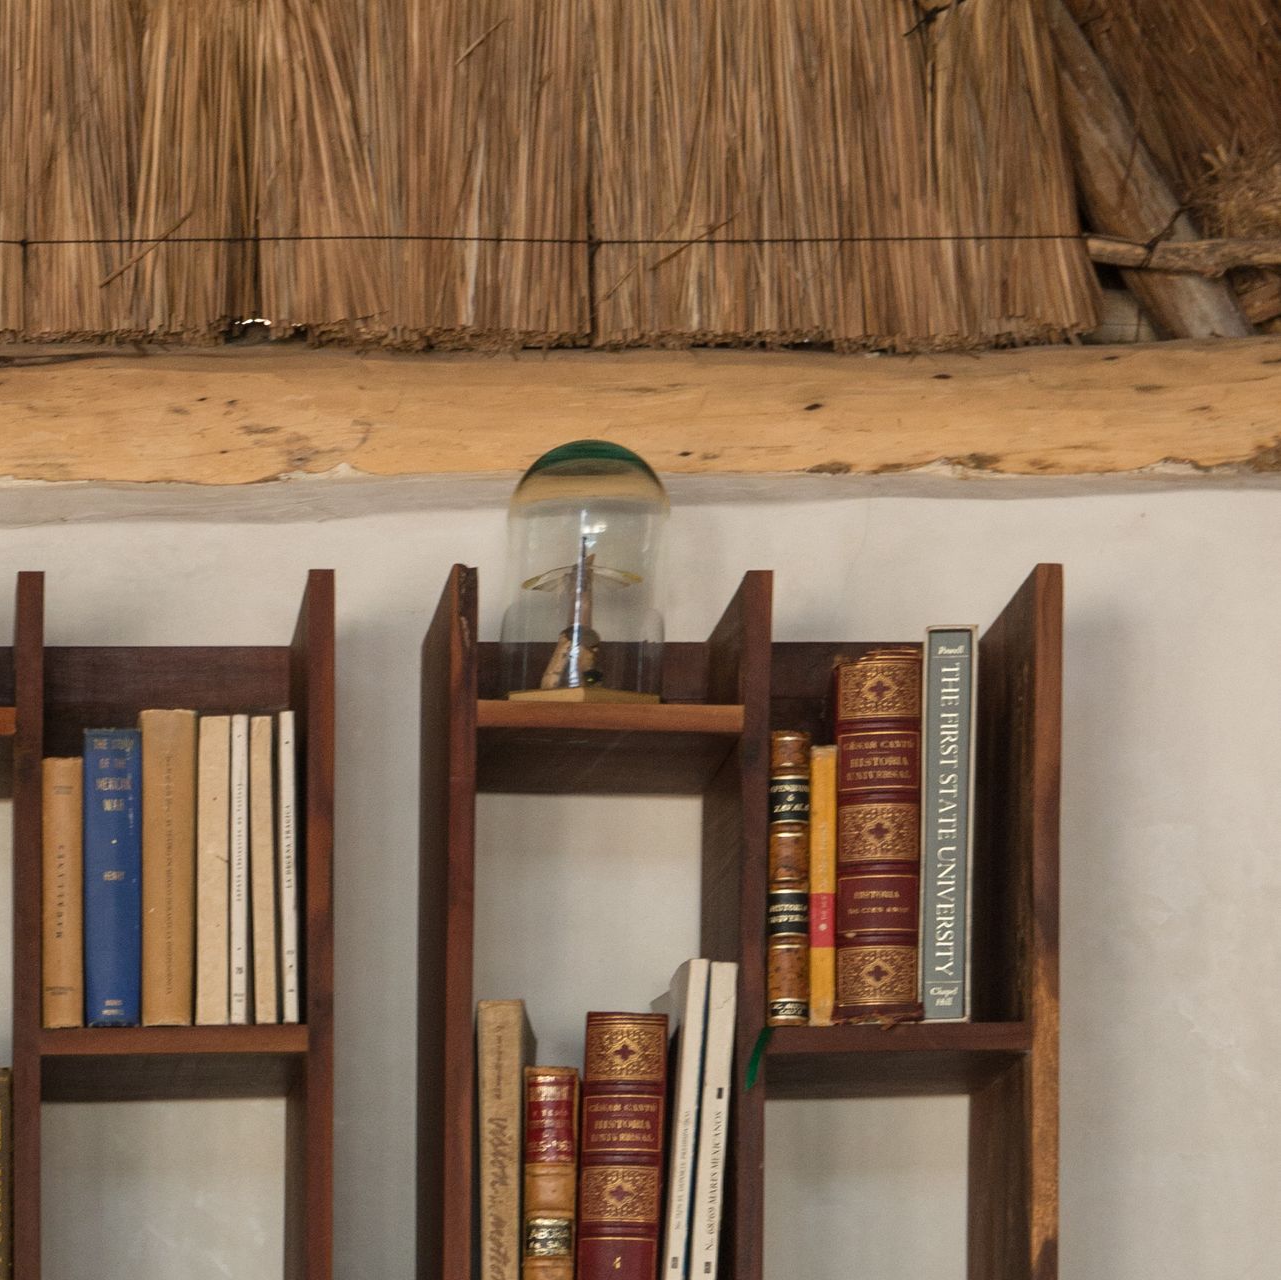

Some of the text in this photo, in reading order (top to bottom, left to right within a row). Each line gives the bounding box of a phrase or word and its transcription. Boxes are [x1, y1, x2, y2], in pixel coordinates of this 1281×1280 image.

[849, 756, 909, 769] HISTORIA
[846, 771, 911, 781] UNIVERSAL
[934, 661, 961, 977] THE FIRST STATE UNIVERSITY
[594, 1119, 652, 1130] HISTORIA
[711, 1110, 723, 1170] MEXICANOS
[708, 1172, 720, 1204] MARES
